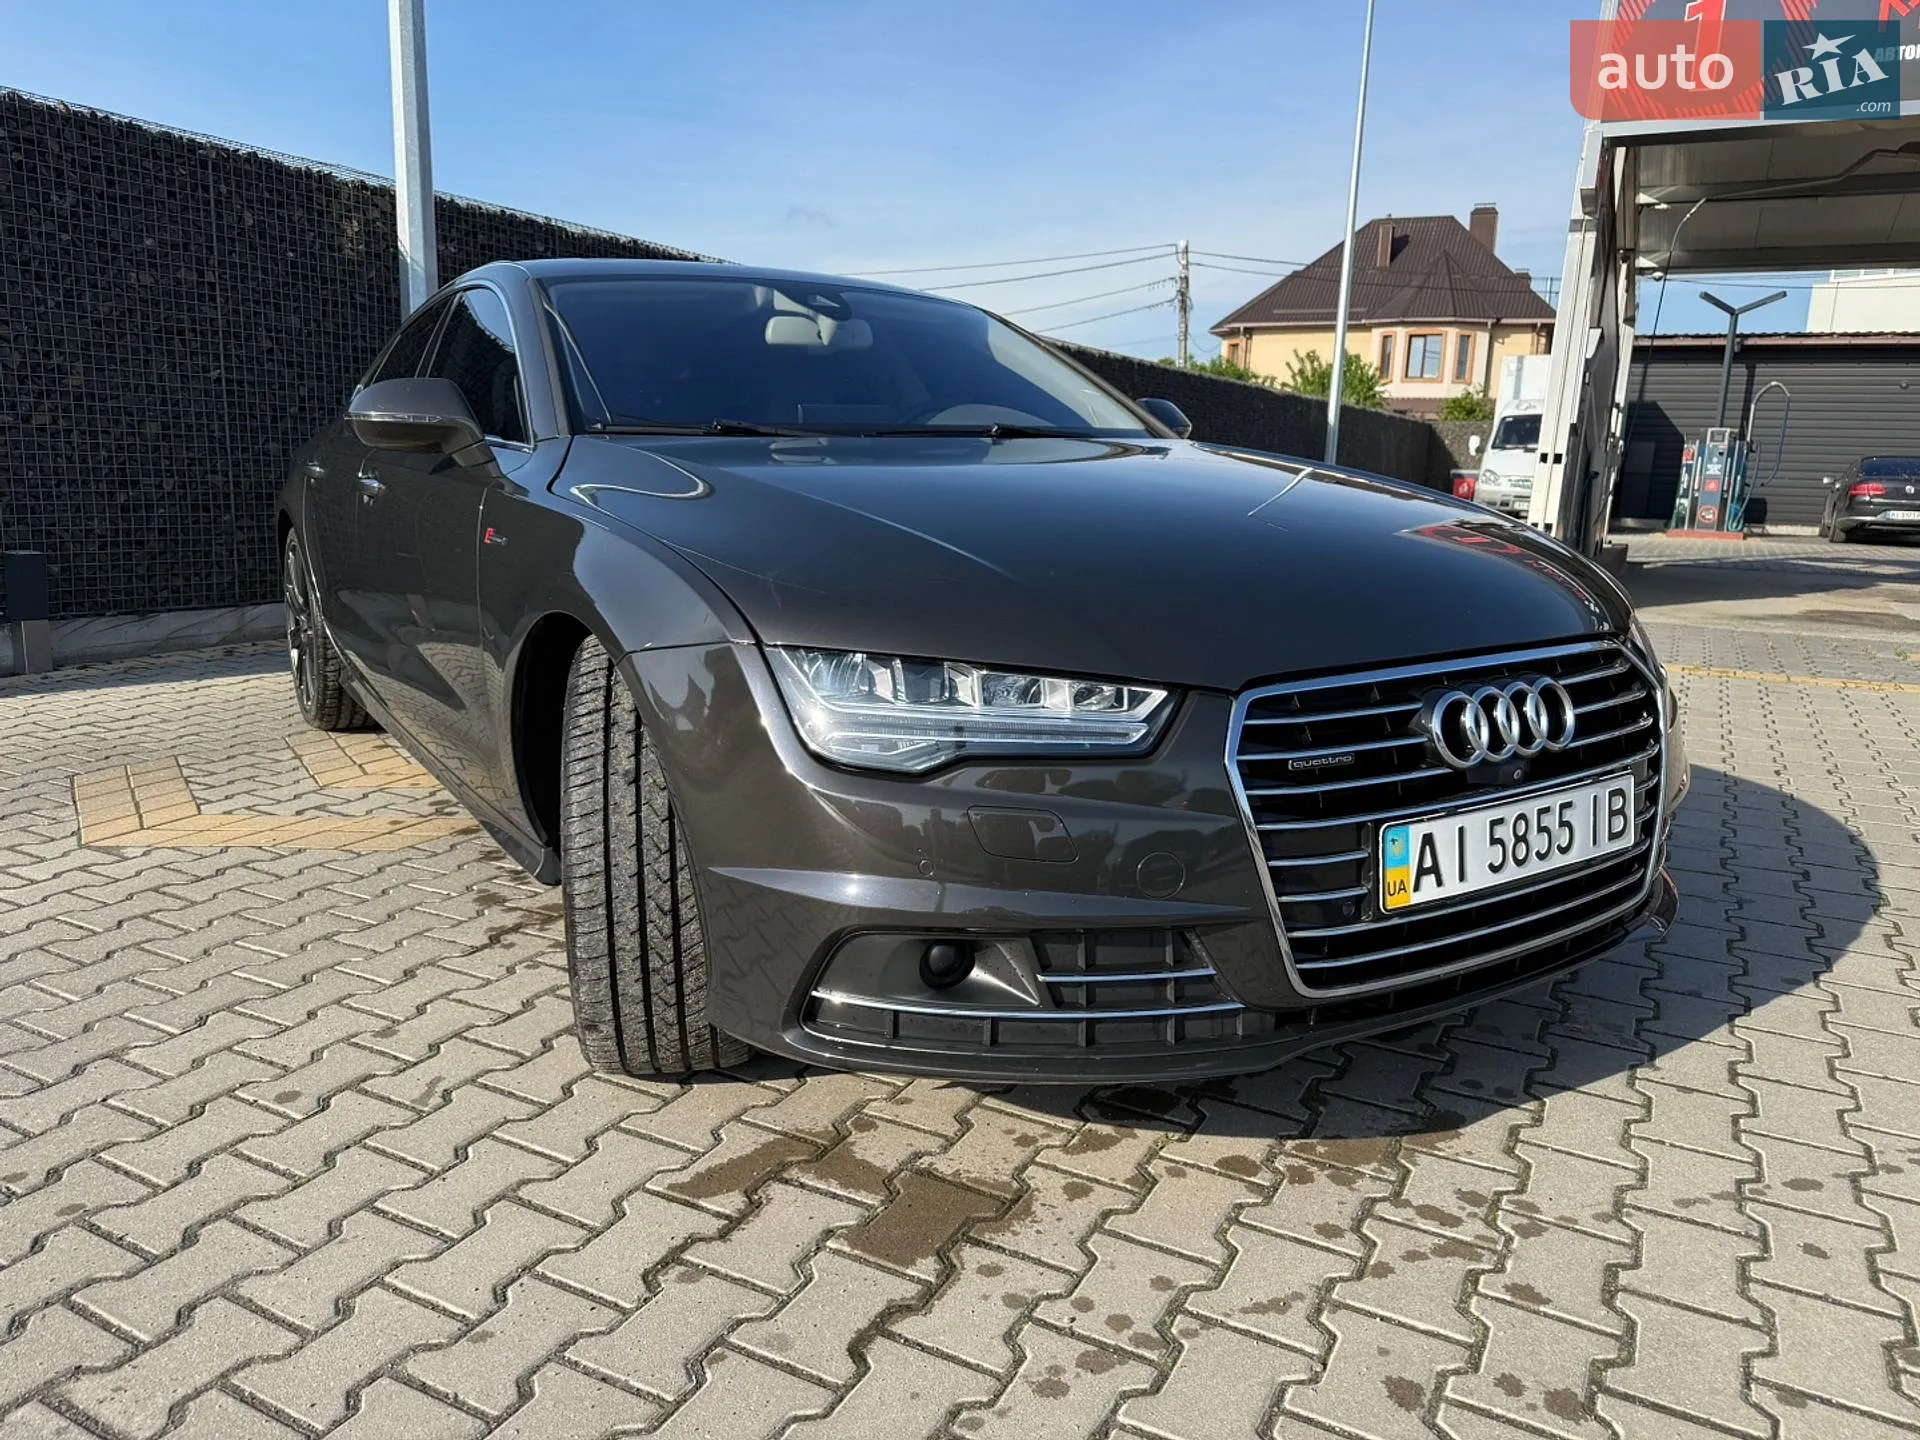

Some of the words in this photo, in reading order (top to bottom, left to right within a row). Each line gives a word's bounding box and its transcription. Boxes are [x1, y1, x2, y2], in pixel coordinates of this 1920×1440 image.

[1874, 44, 1920, 62] АВТО
[1292, 755, 1353, 769] quattro
[1413, 826, 1465, 893] AI
[1487, 801, 1574, 874] 5855
[1591, 787, 1628, 847] IB
[1387, 879, 1408, 897] UA
